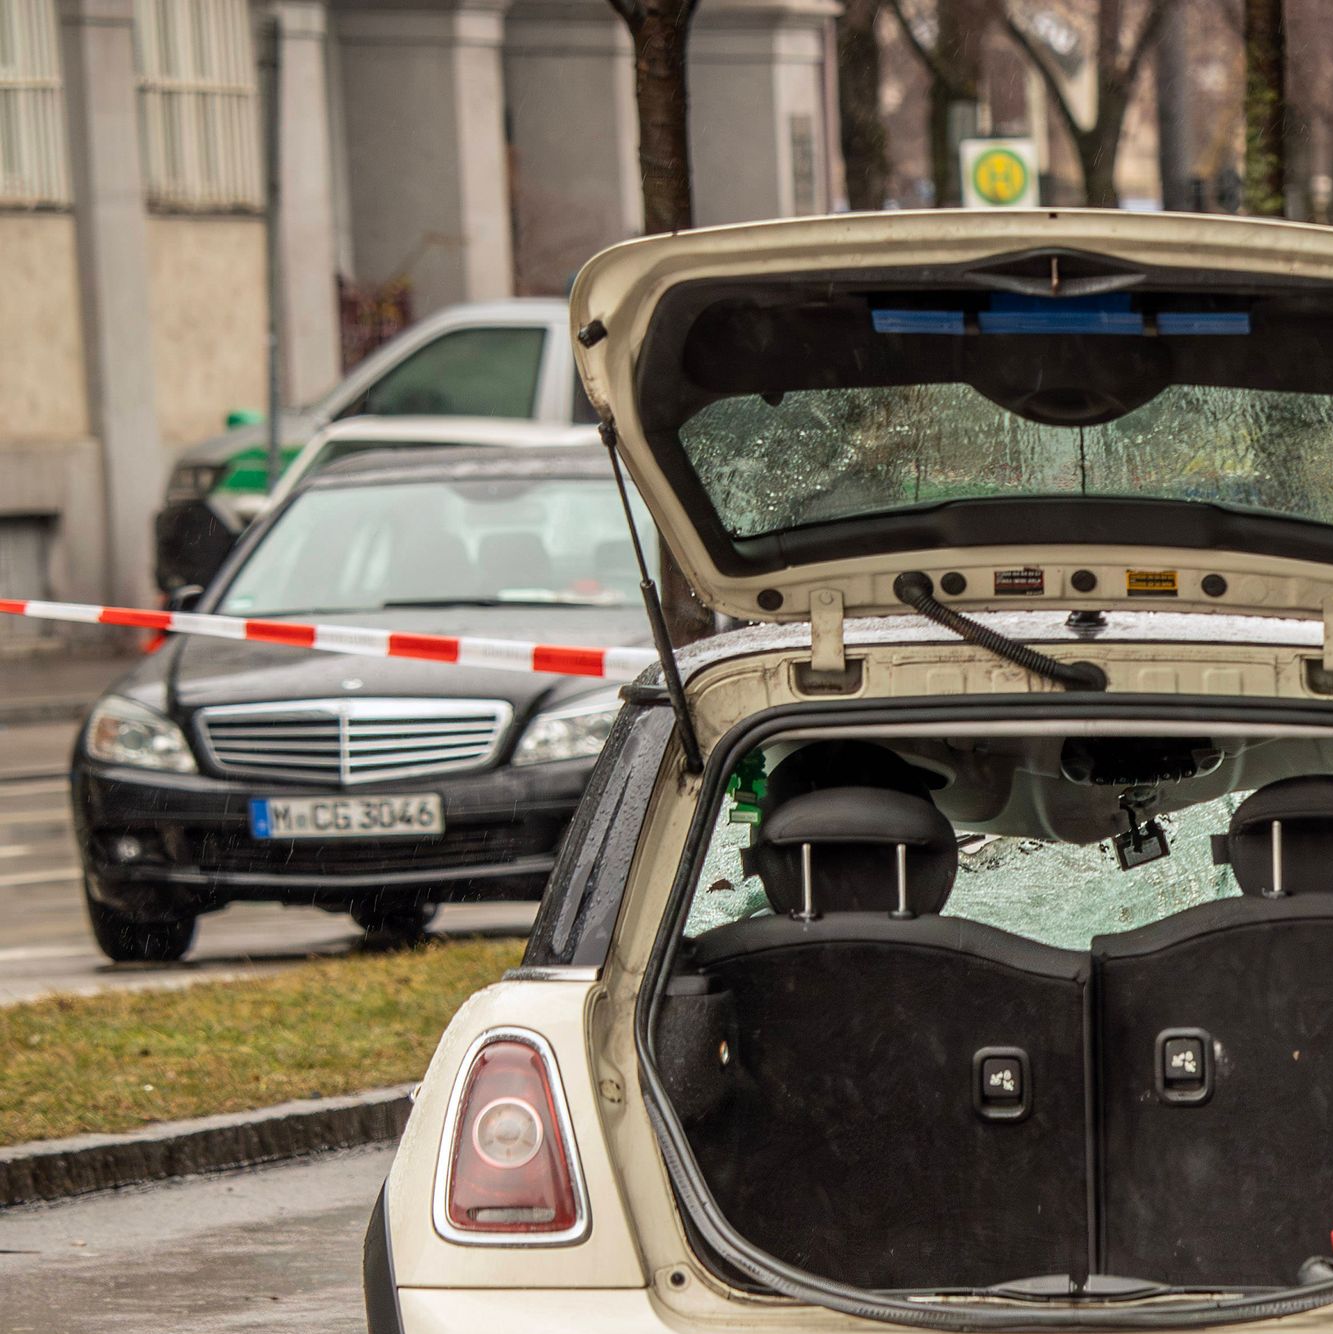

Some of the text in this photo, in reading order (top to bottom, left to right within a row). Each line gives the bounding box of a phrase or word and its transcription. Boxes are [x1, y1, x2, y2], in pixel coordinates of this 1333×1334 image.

[272, 799, 435, 832] M CG 3046
